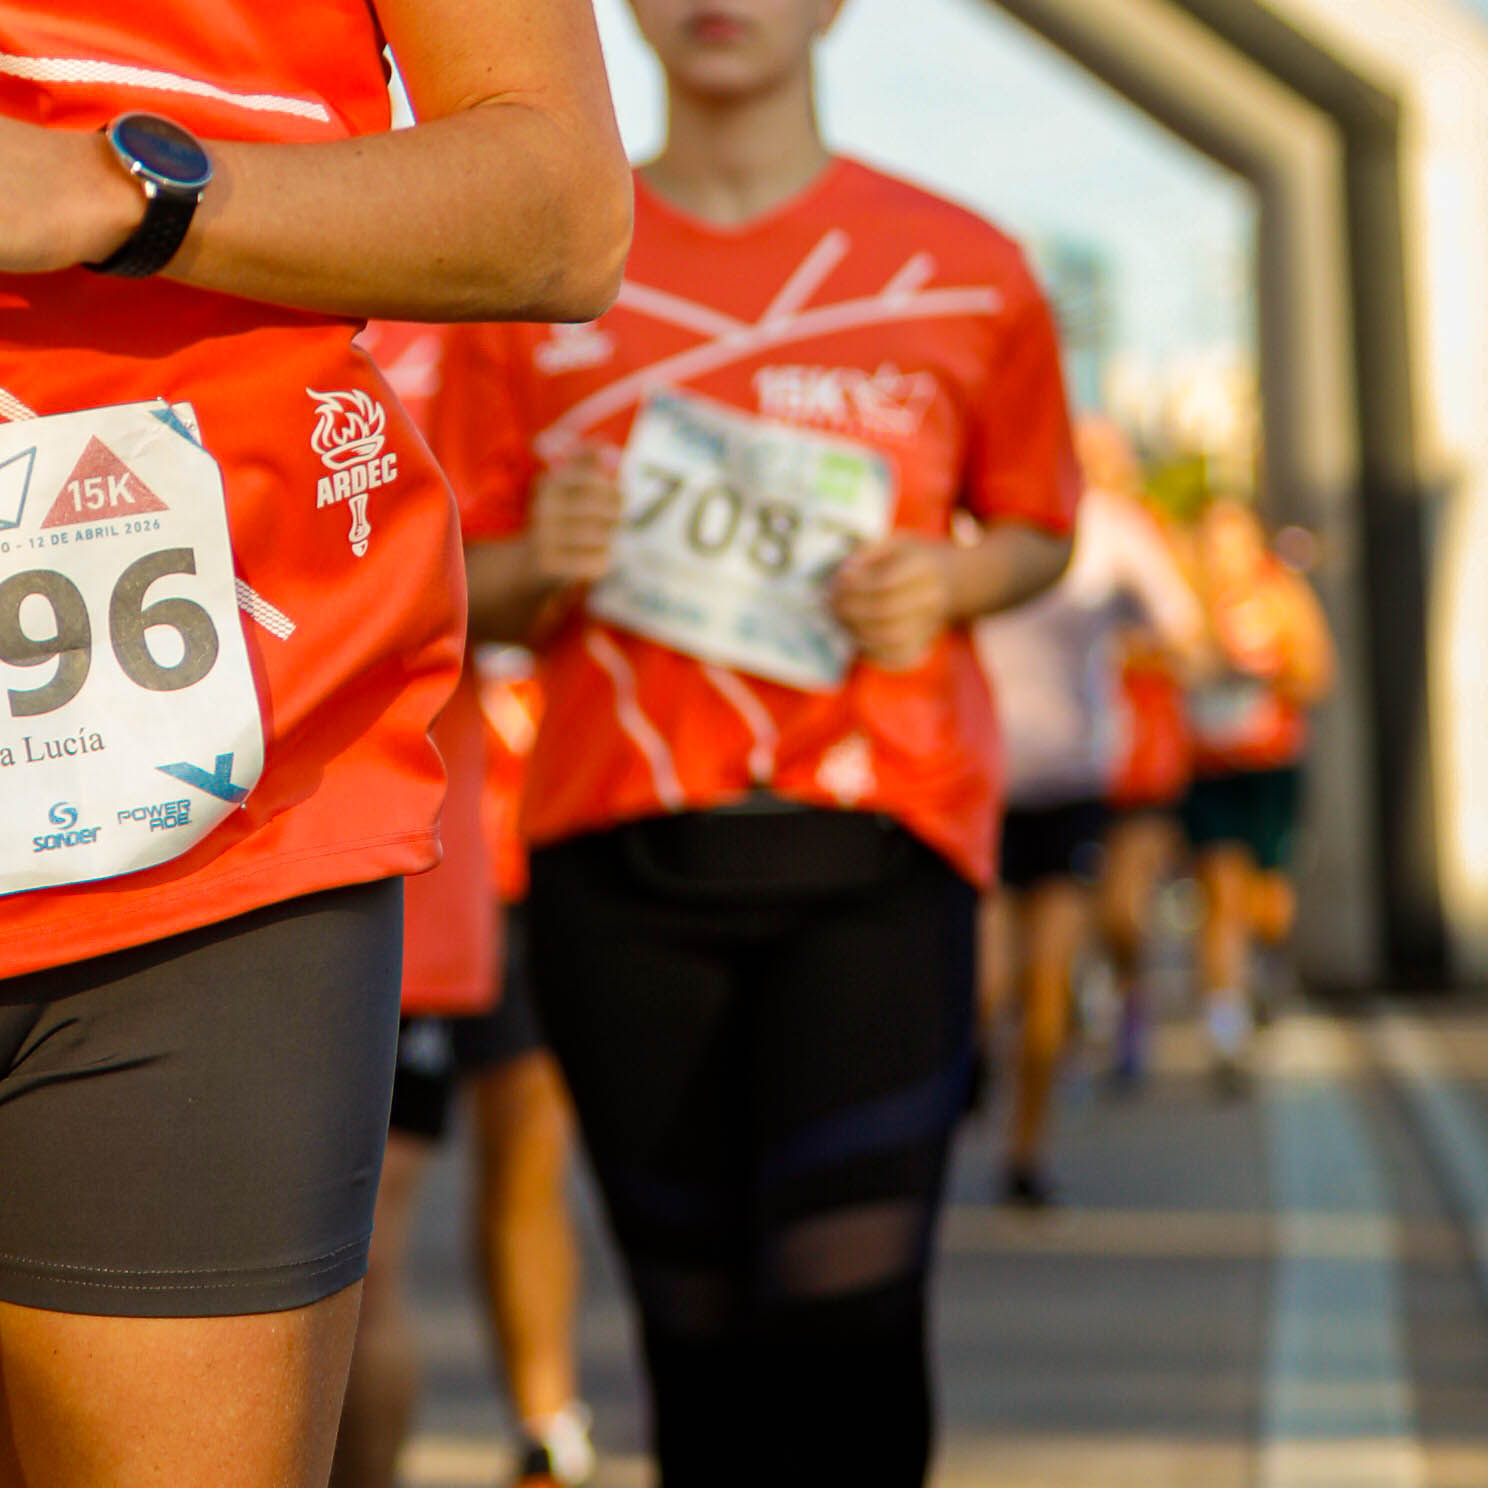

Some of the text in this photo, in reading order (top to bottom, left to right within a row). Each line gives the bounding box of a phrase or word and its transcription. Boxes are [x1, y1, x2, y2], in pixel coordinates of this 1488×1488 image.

[67, 471, 136, 513] 15K
[316, 452, 398, 510] ARDEC
[29, 536, 45, 549] 12
[50, 532, 69, 545] DE
[75, 524, 119, 543] ABRIL
[124, 518, 162, 535] 2026
[22, 727, 105, 763] Lucía
[117, 798, 192, 825] POWER
